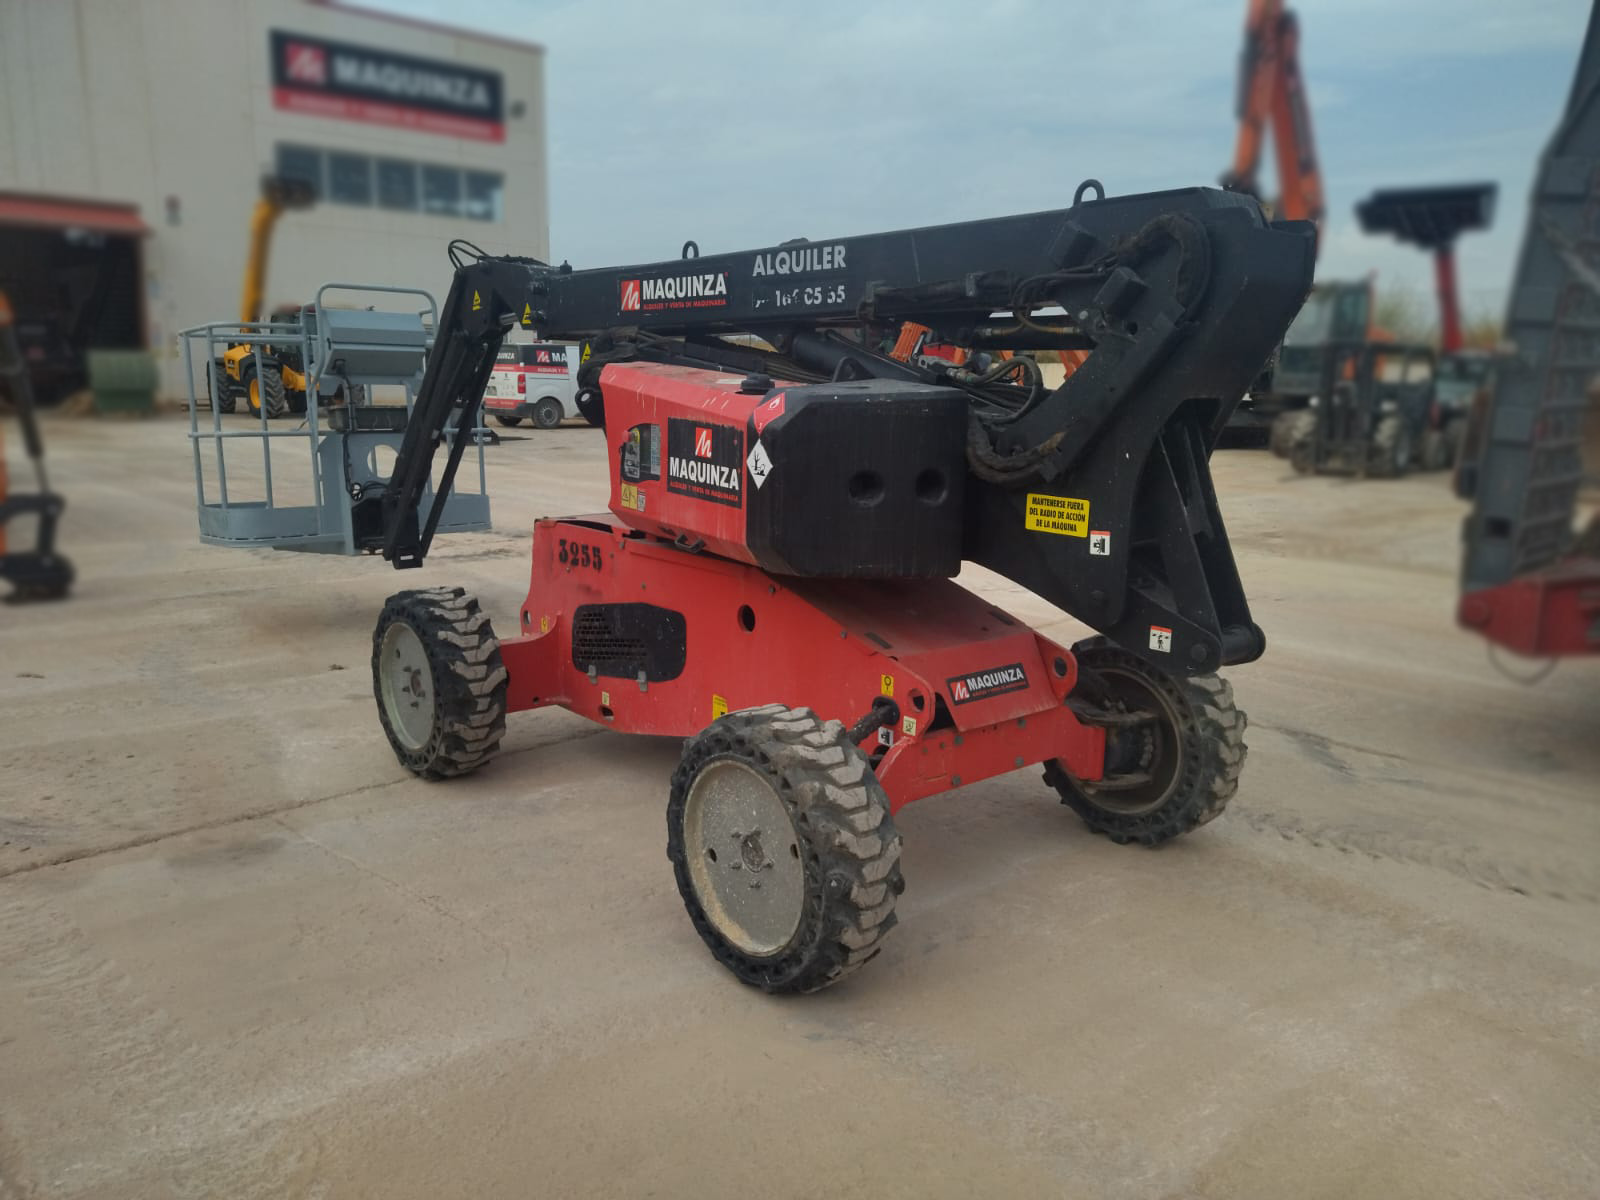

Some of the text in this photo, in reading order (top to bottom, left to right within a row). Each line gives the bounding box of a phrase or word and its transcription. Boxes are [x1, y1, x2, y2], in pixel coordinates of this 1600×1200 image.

[332, 54, 491, 109] MAQUINZA
[752, 245, 847, 277] ALQUILER
[642, 272, 727, 300] MAQUINZA
[669, 456, 740, 491] MAQUINZA
[1029, 507, 1039, 516] DEL
[1040, 508, 1057, 519] RADIO
[1058, 511, 1065, 520] DE
[1032, 496, 1084, 511] MANTENERSE FUERA
[1036, 518, 1043, 527] DE
[1044, 520, 1051, 528] LA
[966, 667, 1025, 692] MAQUINZA
